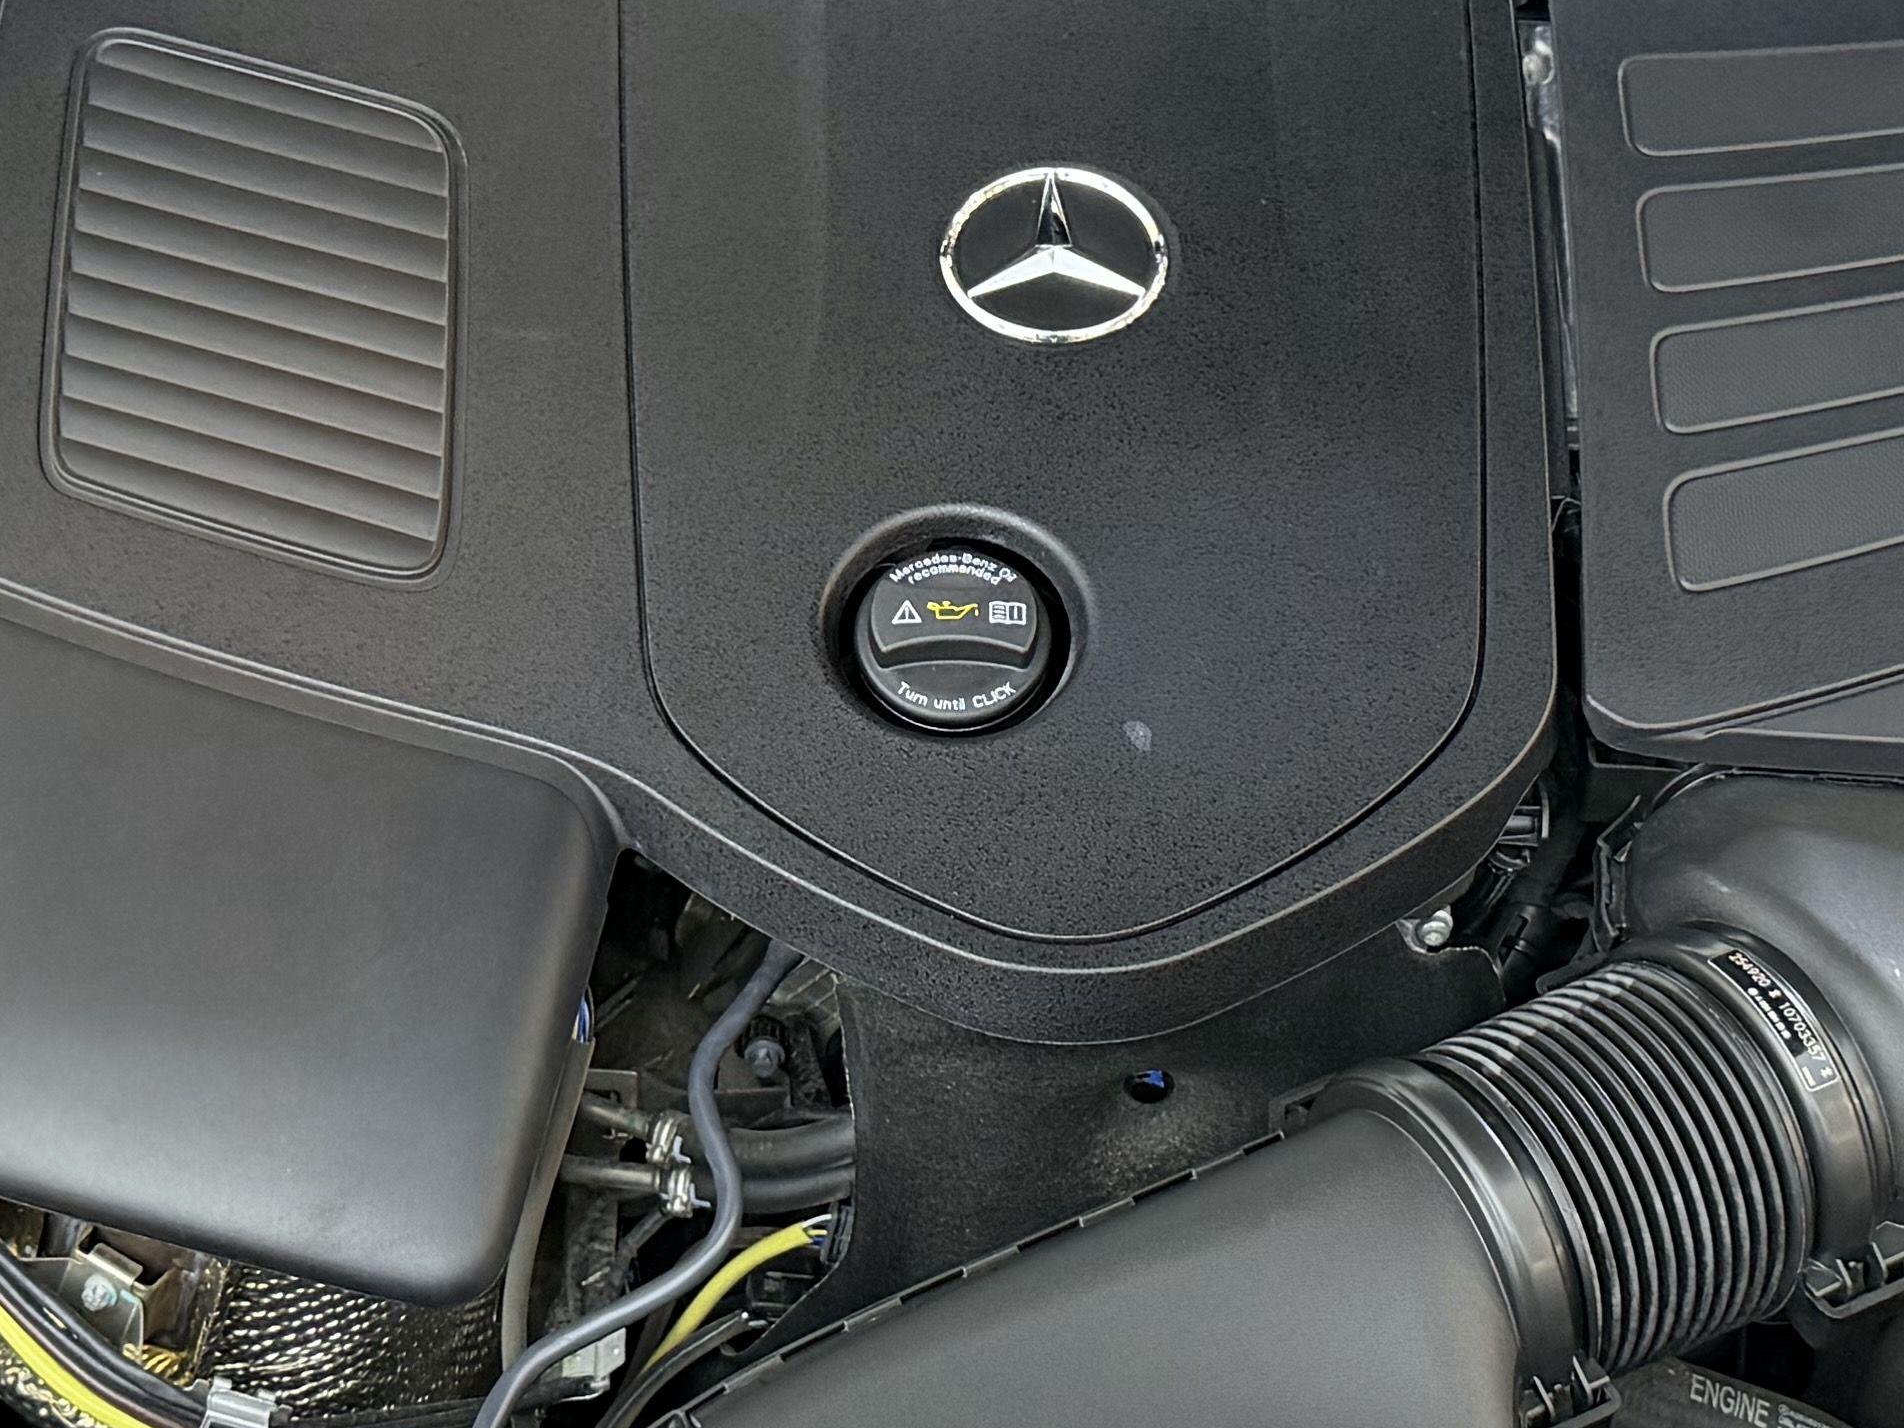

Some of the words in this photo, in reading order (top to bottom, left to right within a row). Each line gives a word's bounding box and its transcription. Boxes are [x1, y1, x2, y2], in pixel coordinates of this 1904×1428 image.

[889, 553, 997, 584] Mercedes-Benz
[907, 563, 1001, 586] recommended
[896, 681, 928, 707] Turn
[933, 696, 966, 712] until
[971, 681, 1017, 709] CLICK
